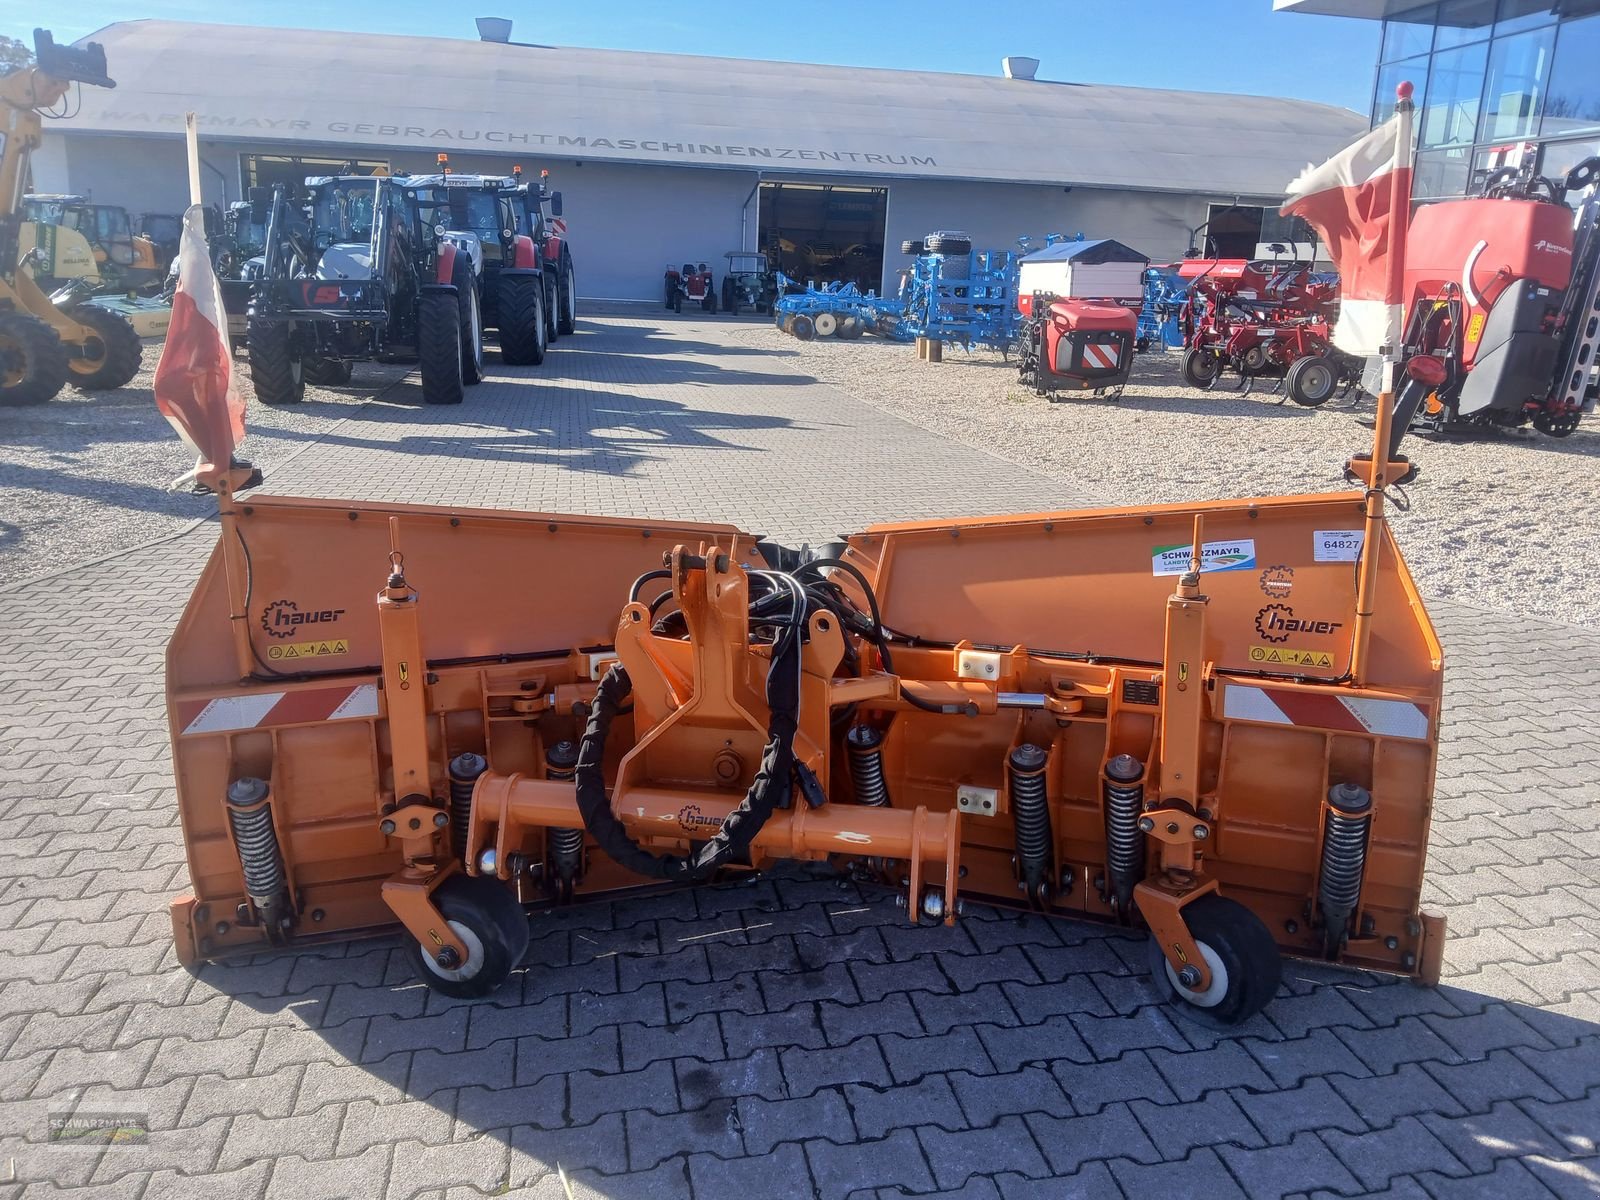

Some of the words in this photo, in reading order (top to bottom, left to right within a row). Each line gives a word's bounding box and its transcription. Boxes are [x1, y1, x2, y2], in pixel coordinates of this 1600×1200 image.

[1324, 540, 1360, 549] 64827
[274, 608, 345, 626] hauer
[1268, 612, 1343, 635] hauer
